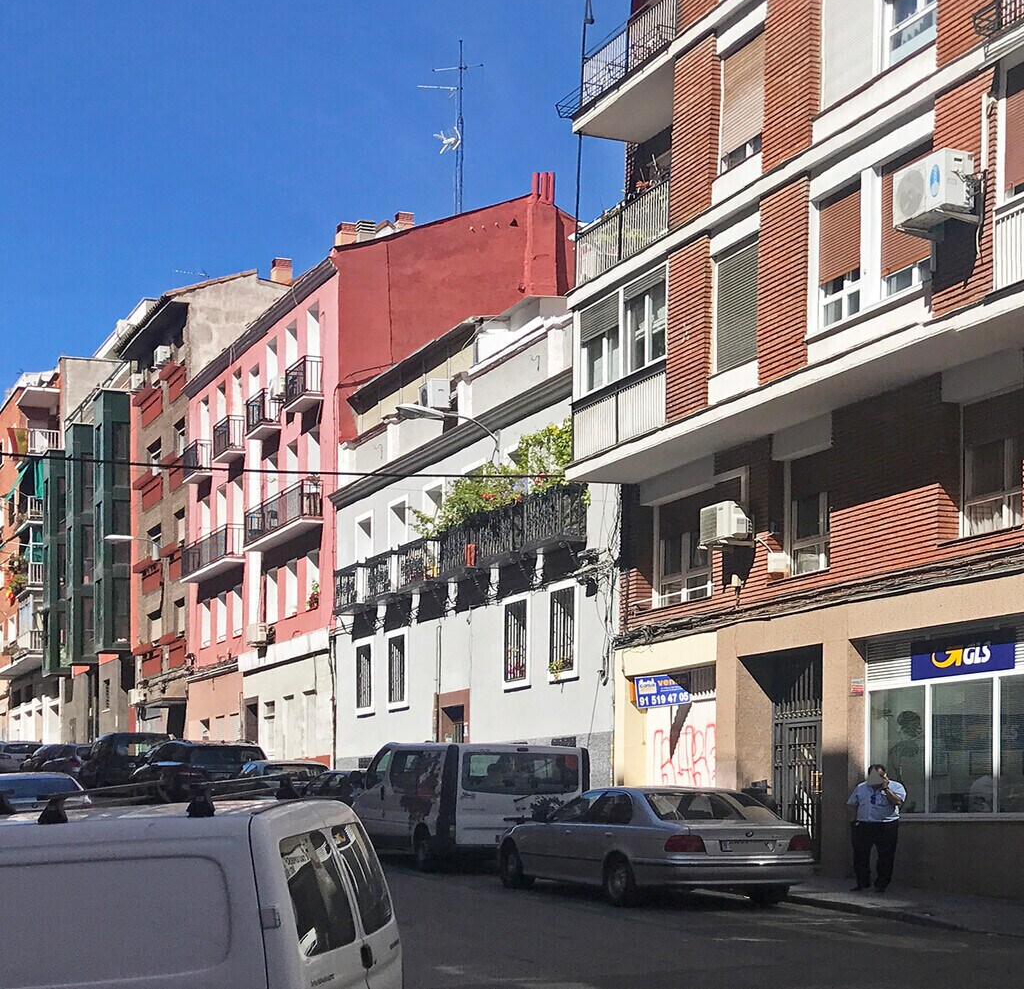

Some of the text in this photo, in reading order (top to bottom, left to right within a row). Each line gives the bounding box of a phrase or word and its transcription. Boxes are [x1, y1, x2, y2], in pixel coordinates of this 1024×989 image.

[962, 641, 991, 666] GLS
[639, 691, 689, 706] 91 519 47 05
